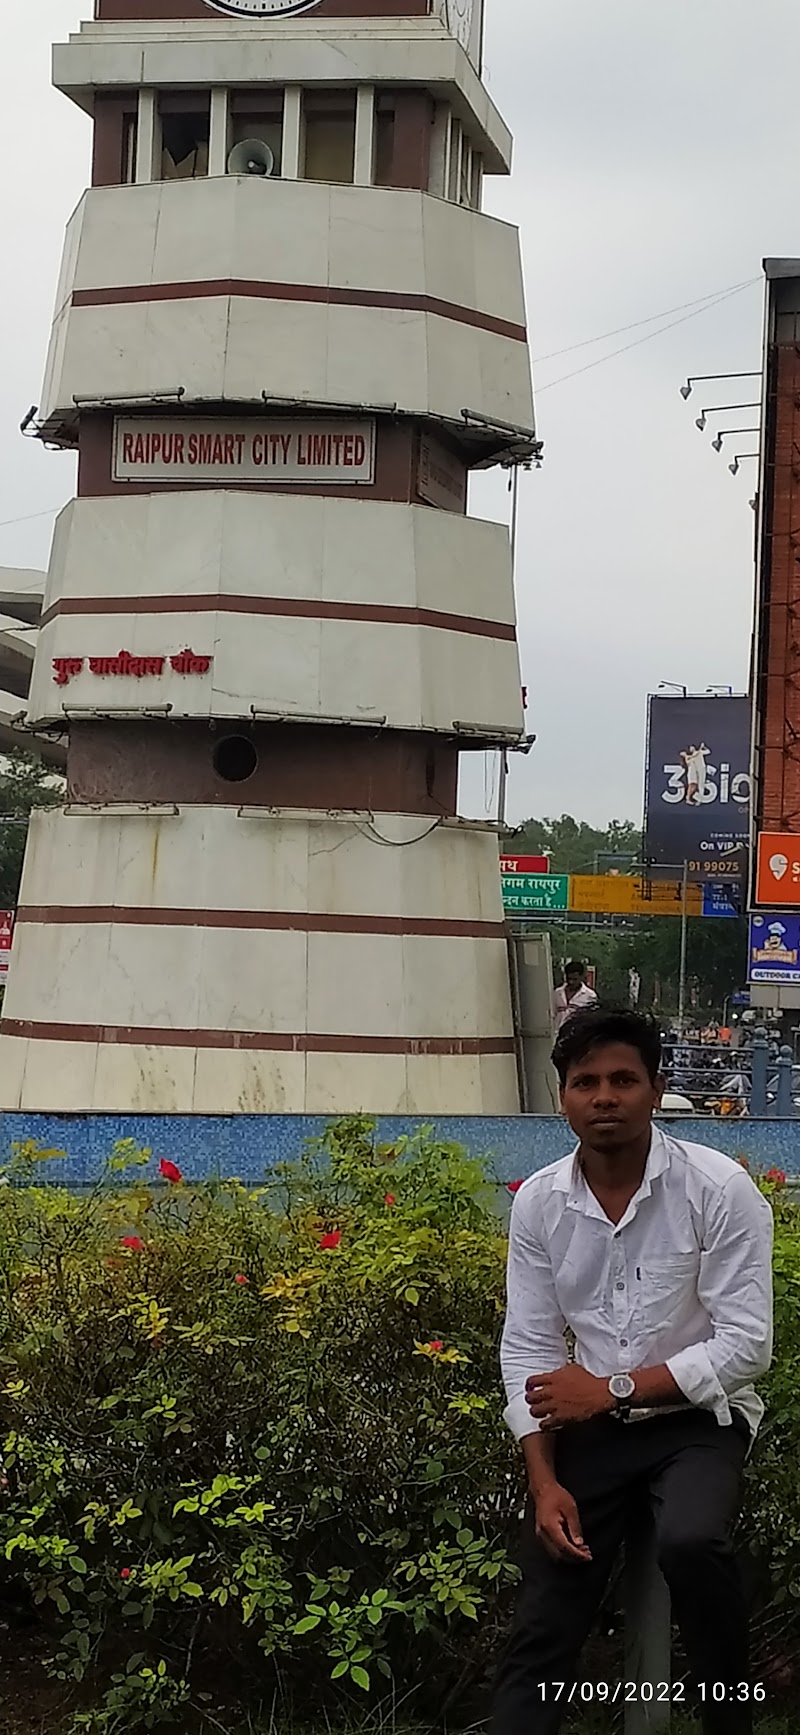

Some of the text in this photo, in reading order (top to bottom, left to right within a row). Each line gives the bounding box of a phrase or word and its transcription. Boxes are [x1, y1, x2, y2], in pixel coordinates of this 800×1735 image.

[122, 433, 366, 466] RAIPUR SMART CITY LIMITED
[700, 841, 715, 851] On
[688, 861, 739, 872] 91 99075
[527, 878, 562, 894] रायपुर
[754, 970, 791, 979] OUTDOOR
